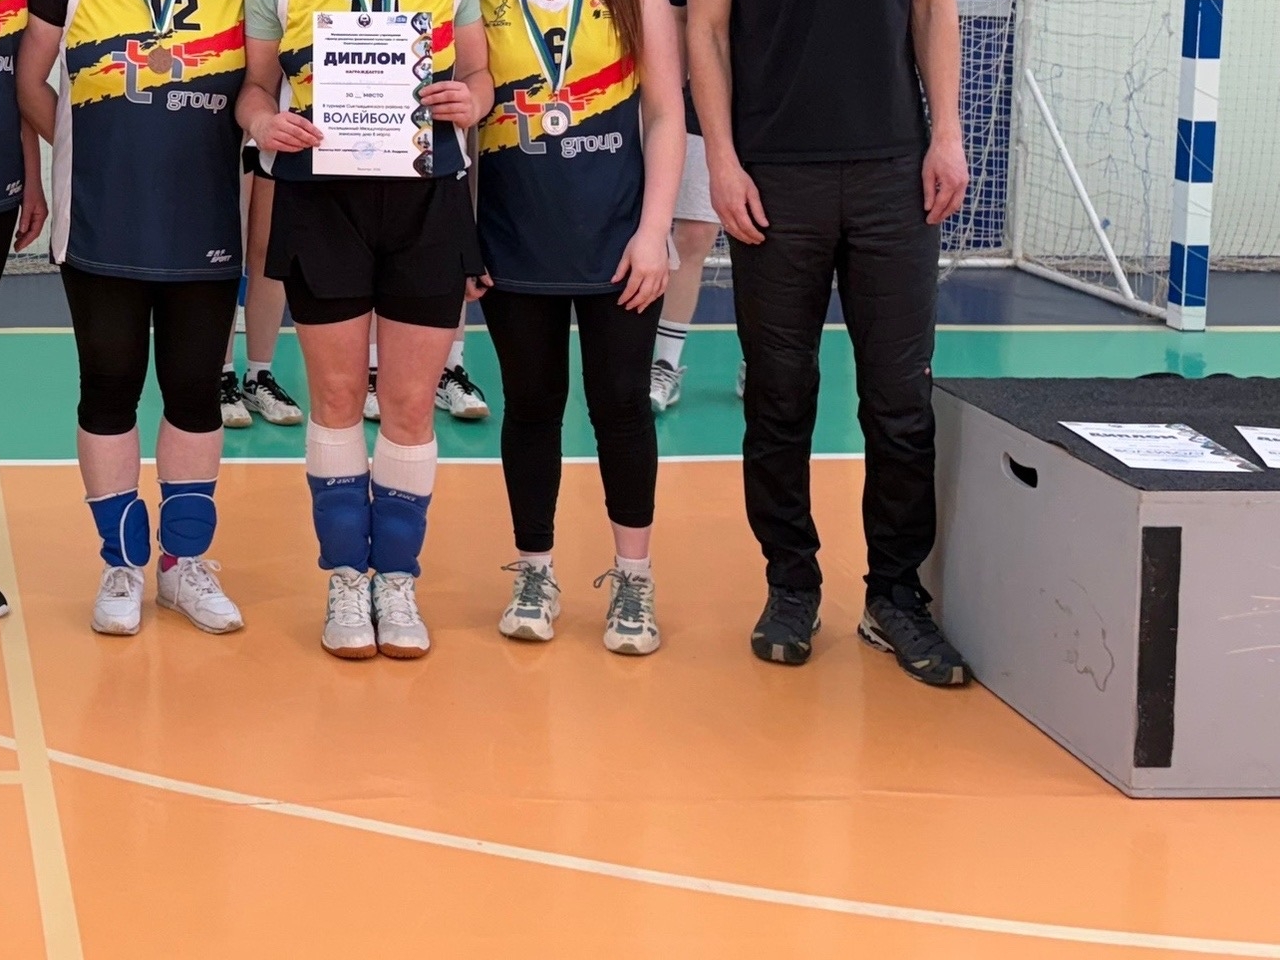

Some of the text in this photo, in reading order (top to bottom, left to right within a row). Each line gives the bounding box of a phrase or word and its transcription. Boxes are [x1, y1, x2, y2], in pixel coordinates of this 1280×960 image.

[323, 51, 406, 67] ДИПЛОМ
[166, 90, 228, 114] group
[323, 109, 406, 124] ВОЛЕЙБОЛУ
[561, 131, 623, 158] group
